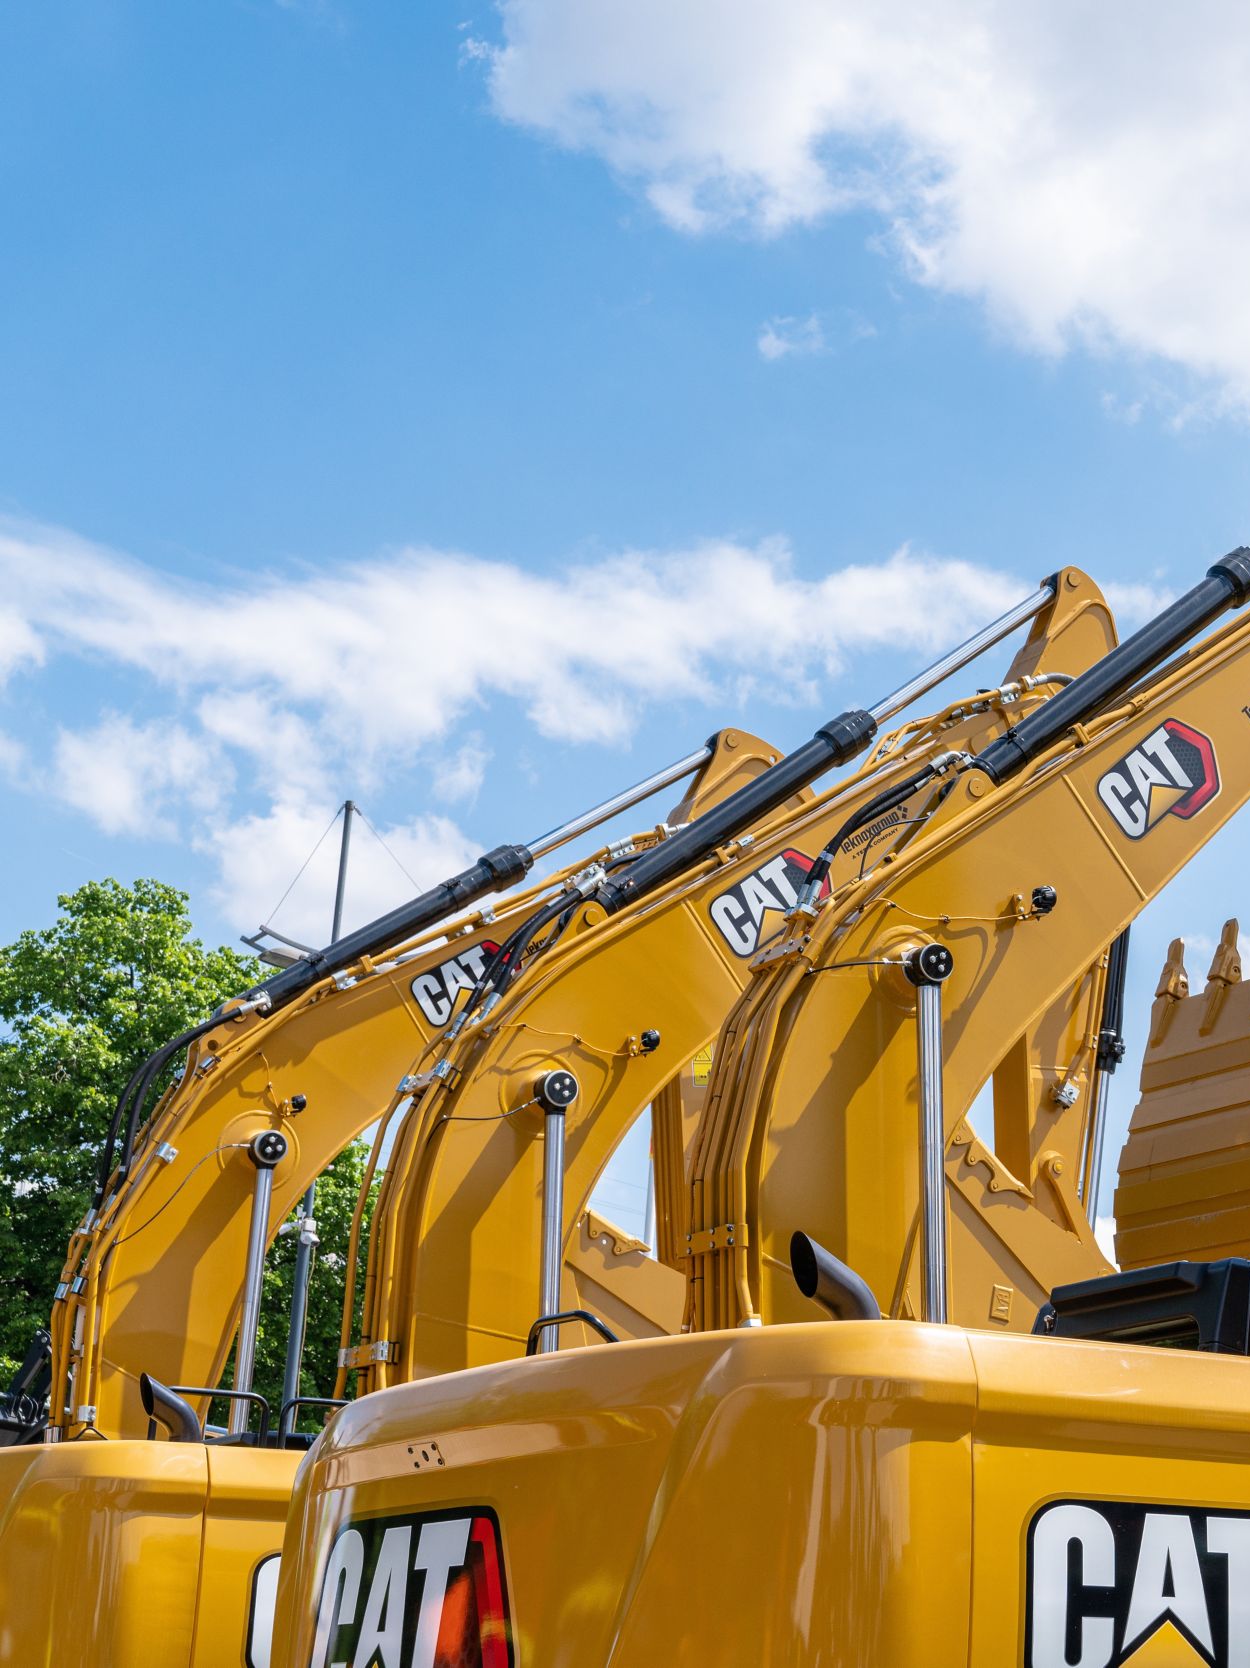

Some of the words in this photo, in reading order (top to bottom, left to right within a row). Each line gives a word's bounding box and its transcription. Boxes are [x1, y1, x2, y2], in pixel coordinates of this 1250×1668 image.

[1098, 727, 1194, 837] CAT
[710, 855, 799, 956] CAT
[411, 945, 495, 1026] CAT
[310, 1517, 473, 1668] CAT
